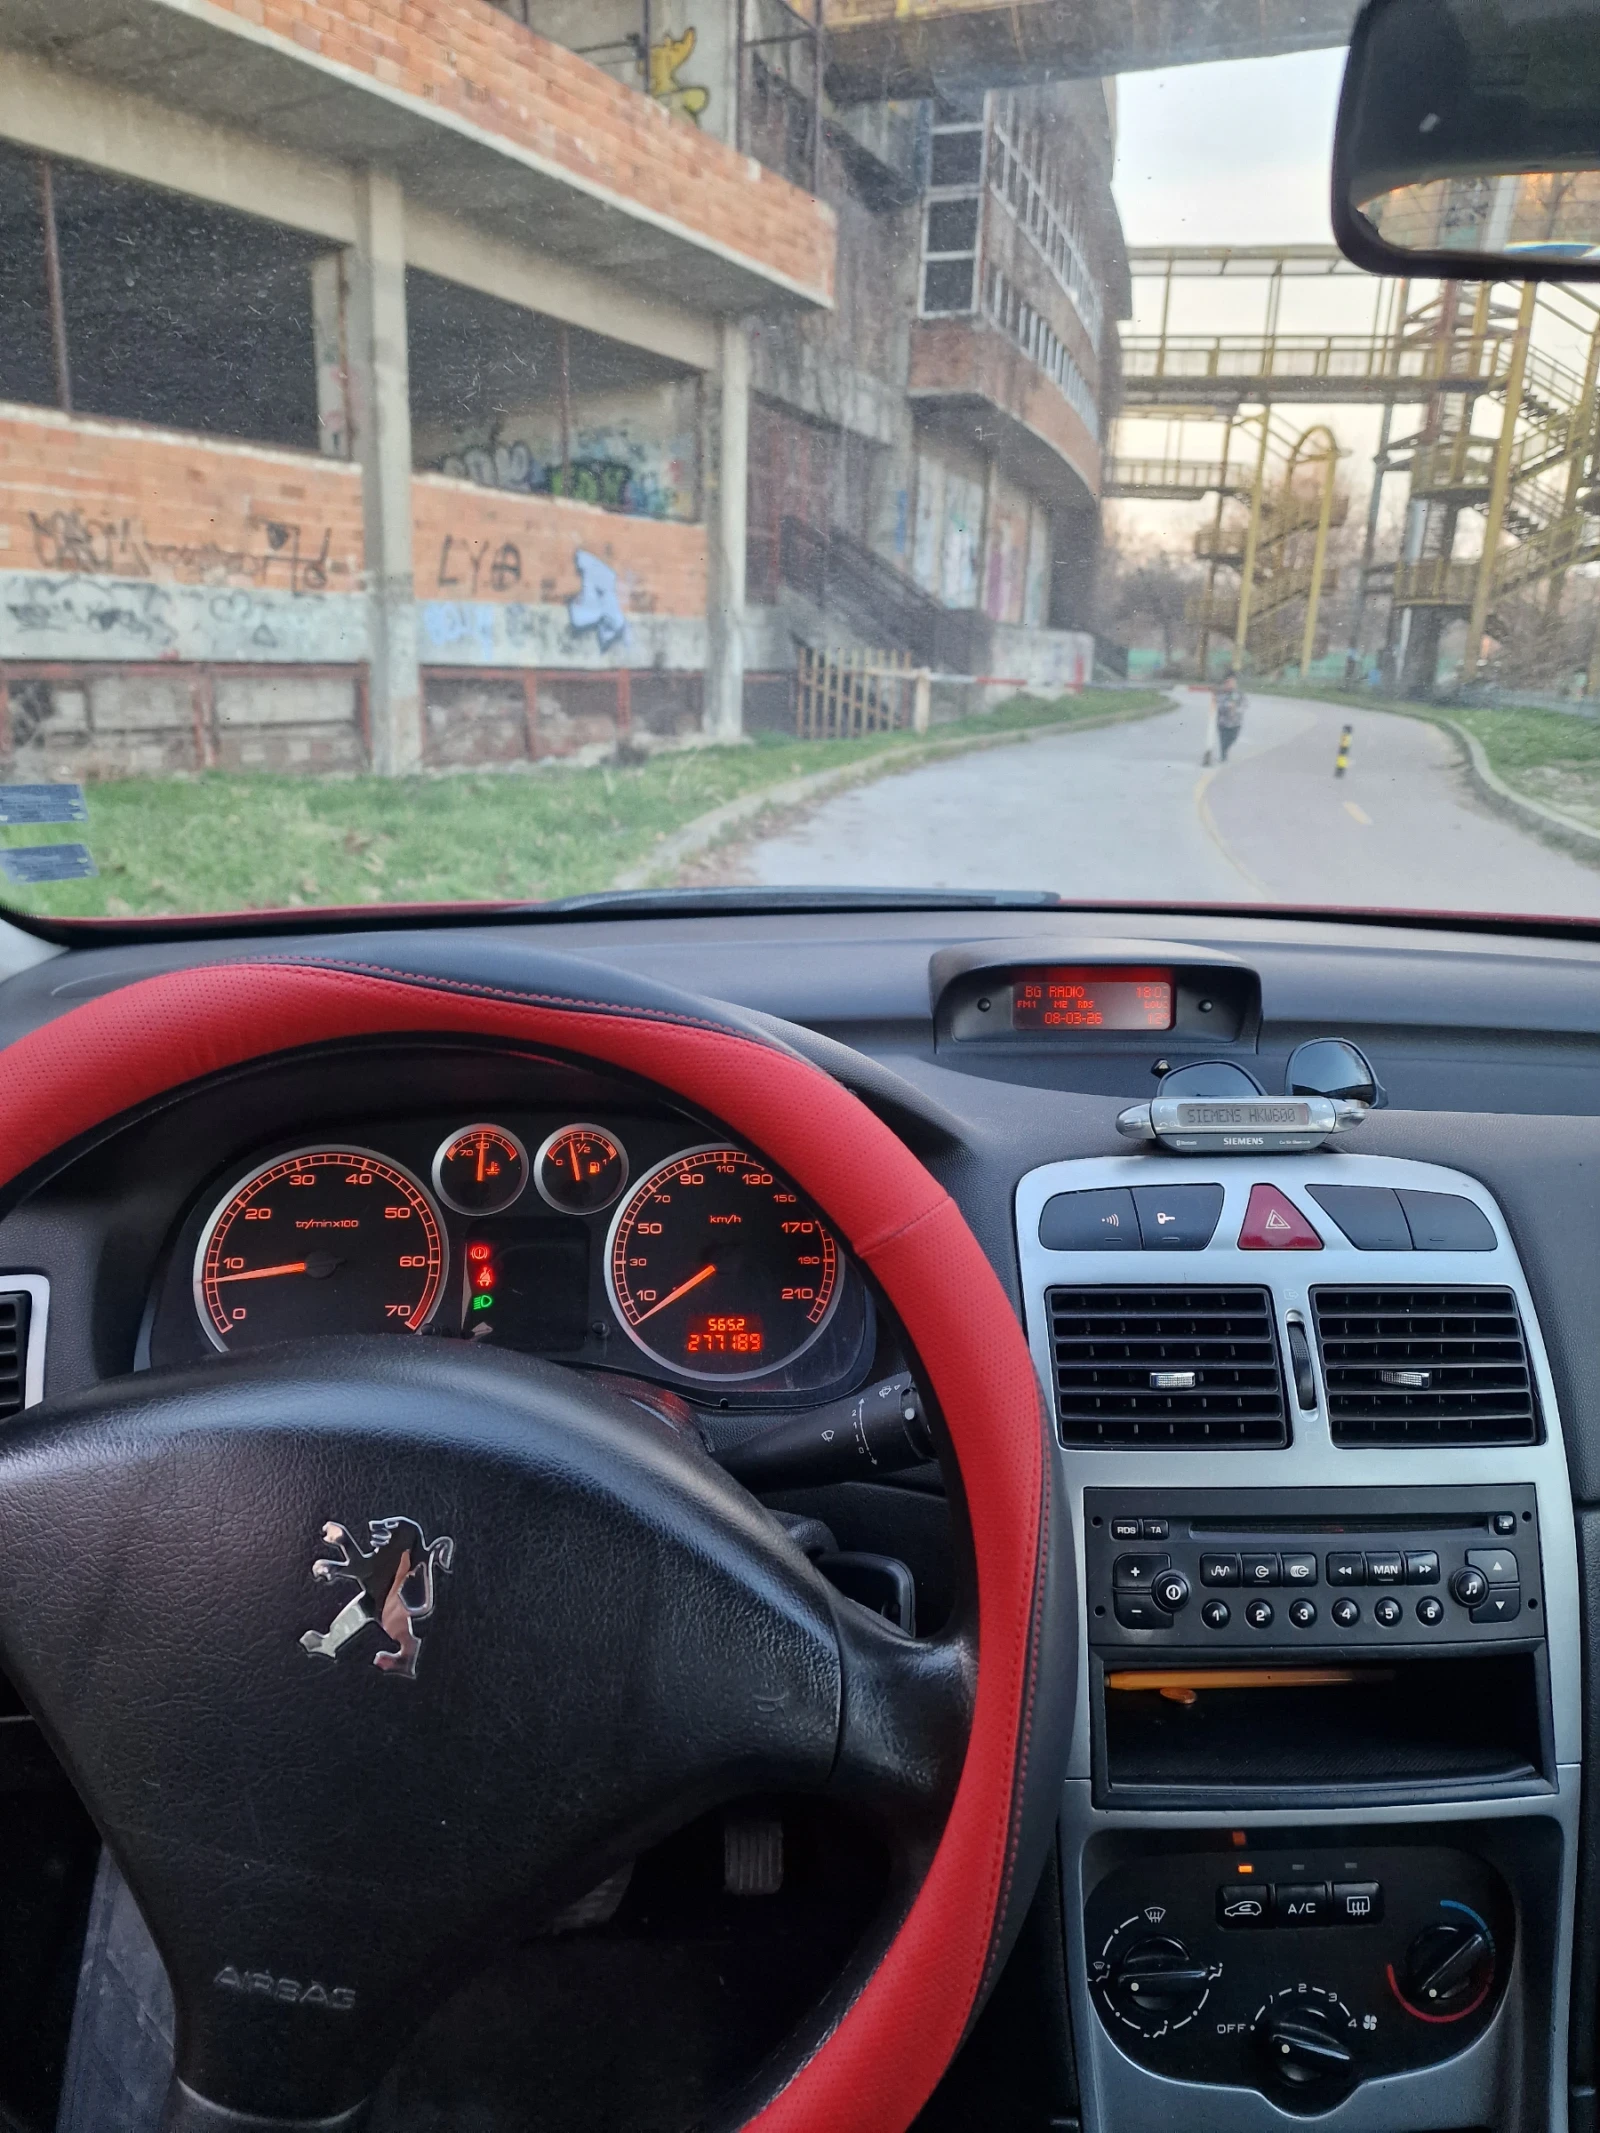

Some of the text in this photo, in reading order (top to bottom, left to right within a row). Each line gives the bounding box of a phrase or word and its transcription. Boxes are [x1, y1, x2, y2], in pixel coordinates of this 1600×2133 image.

[1025, 986, 1042, 998] BG
[1049, 986, 1085, 998] RADIO
[1044, 1012, 1103, 1025] 08-03-26
[1187, 1108, 1296, 1123] SIEMENS HKW600
[1223, 1137, 1264, 1146] SIEMENS
[716, 1165, 735, 1173] 110
[289, 1174, 315, 1186] 30
[345, 1174, 372, 1185] 40
[680, 1174, 704, 1185] 90
[742, 1174, 773, 1185] 130
[654, 1195, 671, 1203] 70
[773, 1194, 797, 1203] 150
[245, 1209, 271, 1220] 20
[384, 1208, 411, 1219] 50
[709, 1215, 742, 1224] km/h
[637, 1223, 662, 1234] 50
[781, 1222, 814, 1233] 170
[223, 1257, 244, 1269] 10
[399, 1256, 425, 1267] 60
[629, 1258, 647, 1266] 30
[798, 1257, 820, 1265] 190
[636, 1290, 657, 1301] 10
[782, 1289, 814, 1299] 210
[233, 1308, 246, 1320] 0
[385, 1305, 411, 1317] 70
[688, 1334, 761, 1351] 277189
[1117, 1526, 1136, 1534] RDS
[1150, 1526, 1162, 1534] TA
[1374, 1565, 1398, 1575] MAN
[1211, 1609, 1220, 1621] 1
[1256, 1610, 1265, 1621] 2
[1300, 1608, 1308, 1620] 3
[1341, 1608, 1351, 1620] 4
[1385, 1608, 1394, 1619] 5
[1426, 1606, 1436, 1618] 6
[1288, 1903, 1316, 1914] A/C
[213, 1966, 356, 2009] AIRBAG
[1298, 1983, 1307, 1993] 2
[1328, 1992, 1337, 2002] 3
[1217, 2024, 1246, 2033] OFF
[1348, 2019, 1357, 2028] 4
